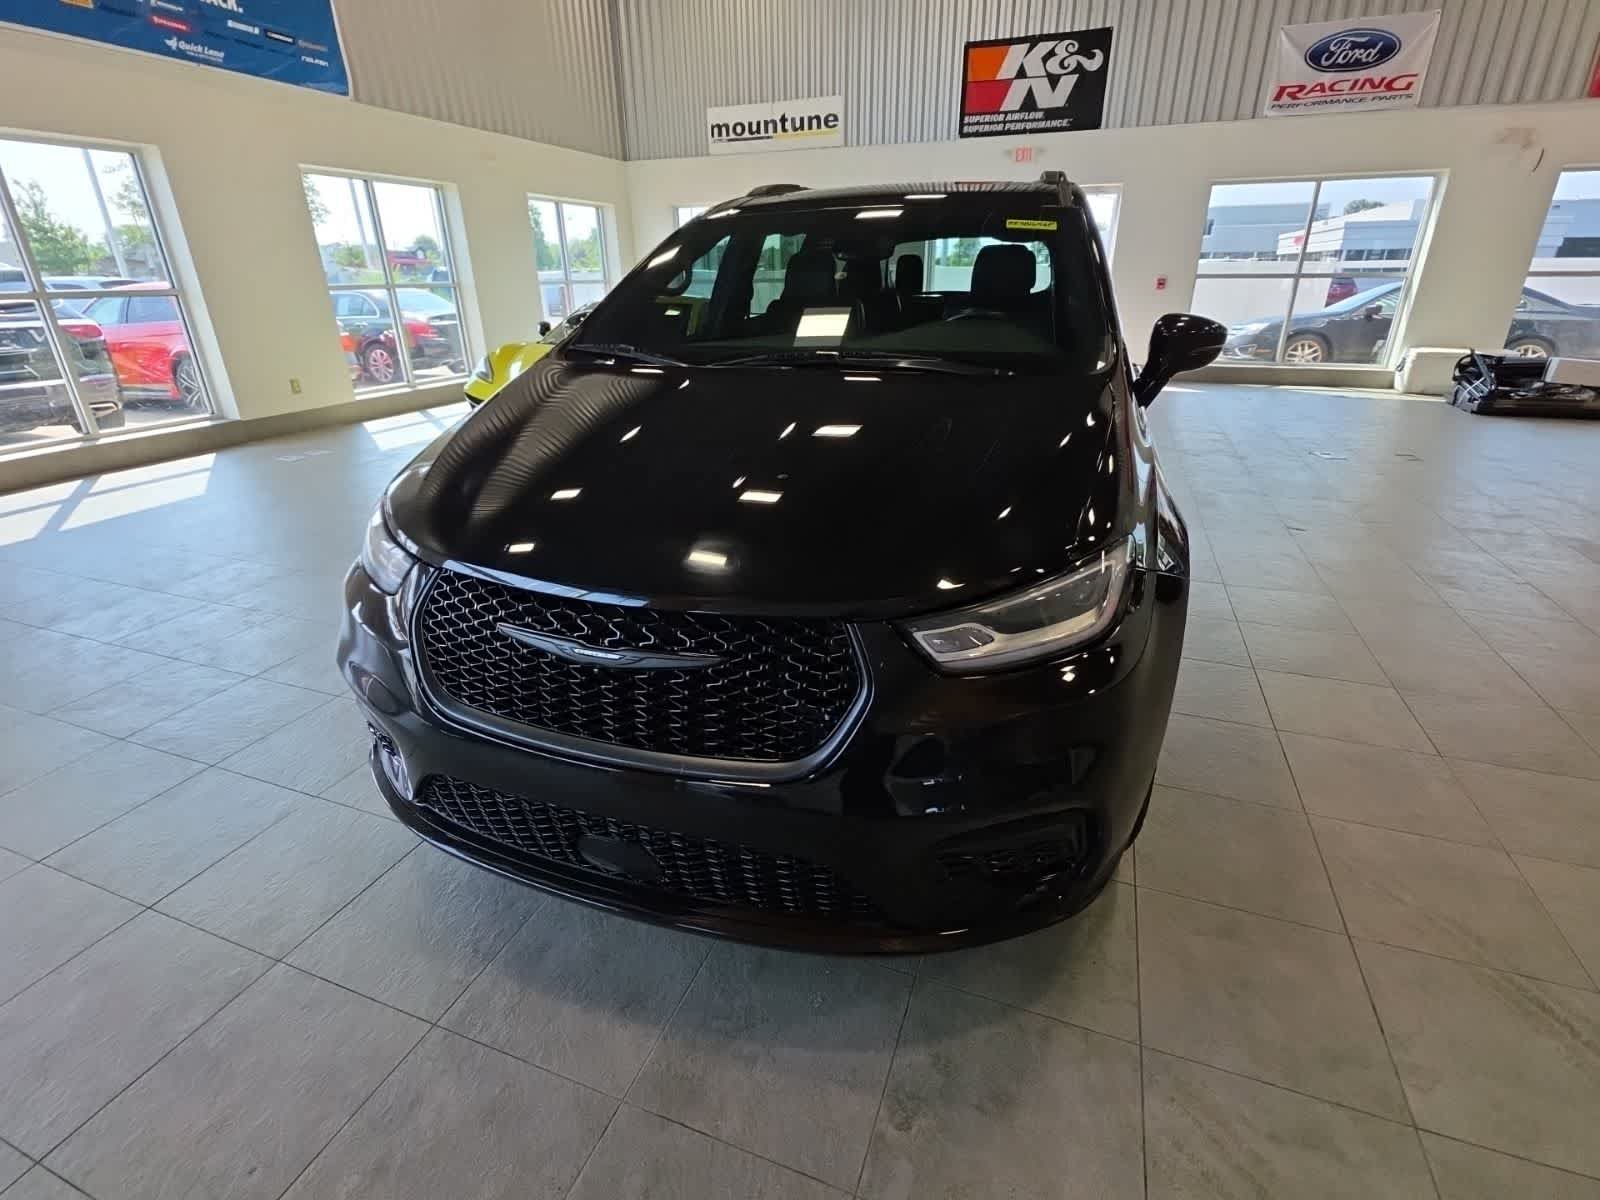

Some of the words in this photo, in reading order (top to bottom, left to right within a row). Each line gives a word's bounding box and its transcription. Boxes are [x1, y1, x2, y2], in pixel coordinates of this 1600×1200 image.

[178, 40, 203, 54] Quick
[1321, 36, 1384, 67] Ford
[1272, 73, 1419, 102] RACING
[1270, 96, 1368, 110] PERFORMANCE
[1371, 93, 1415, 102] PARTS
[710, 112, 840, 139] mountune
[963, 113, 1005, 124] SUPERIOR
[962, 123, 1004, 134] SUPERIOR
